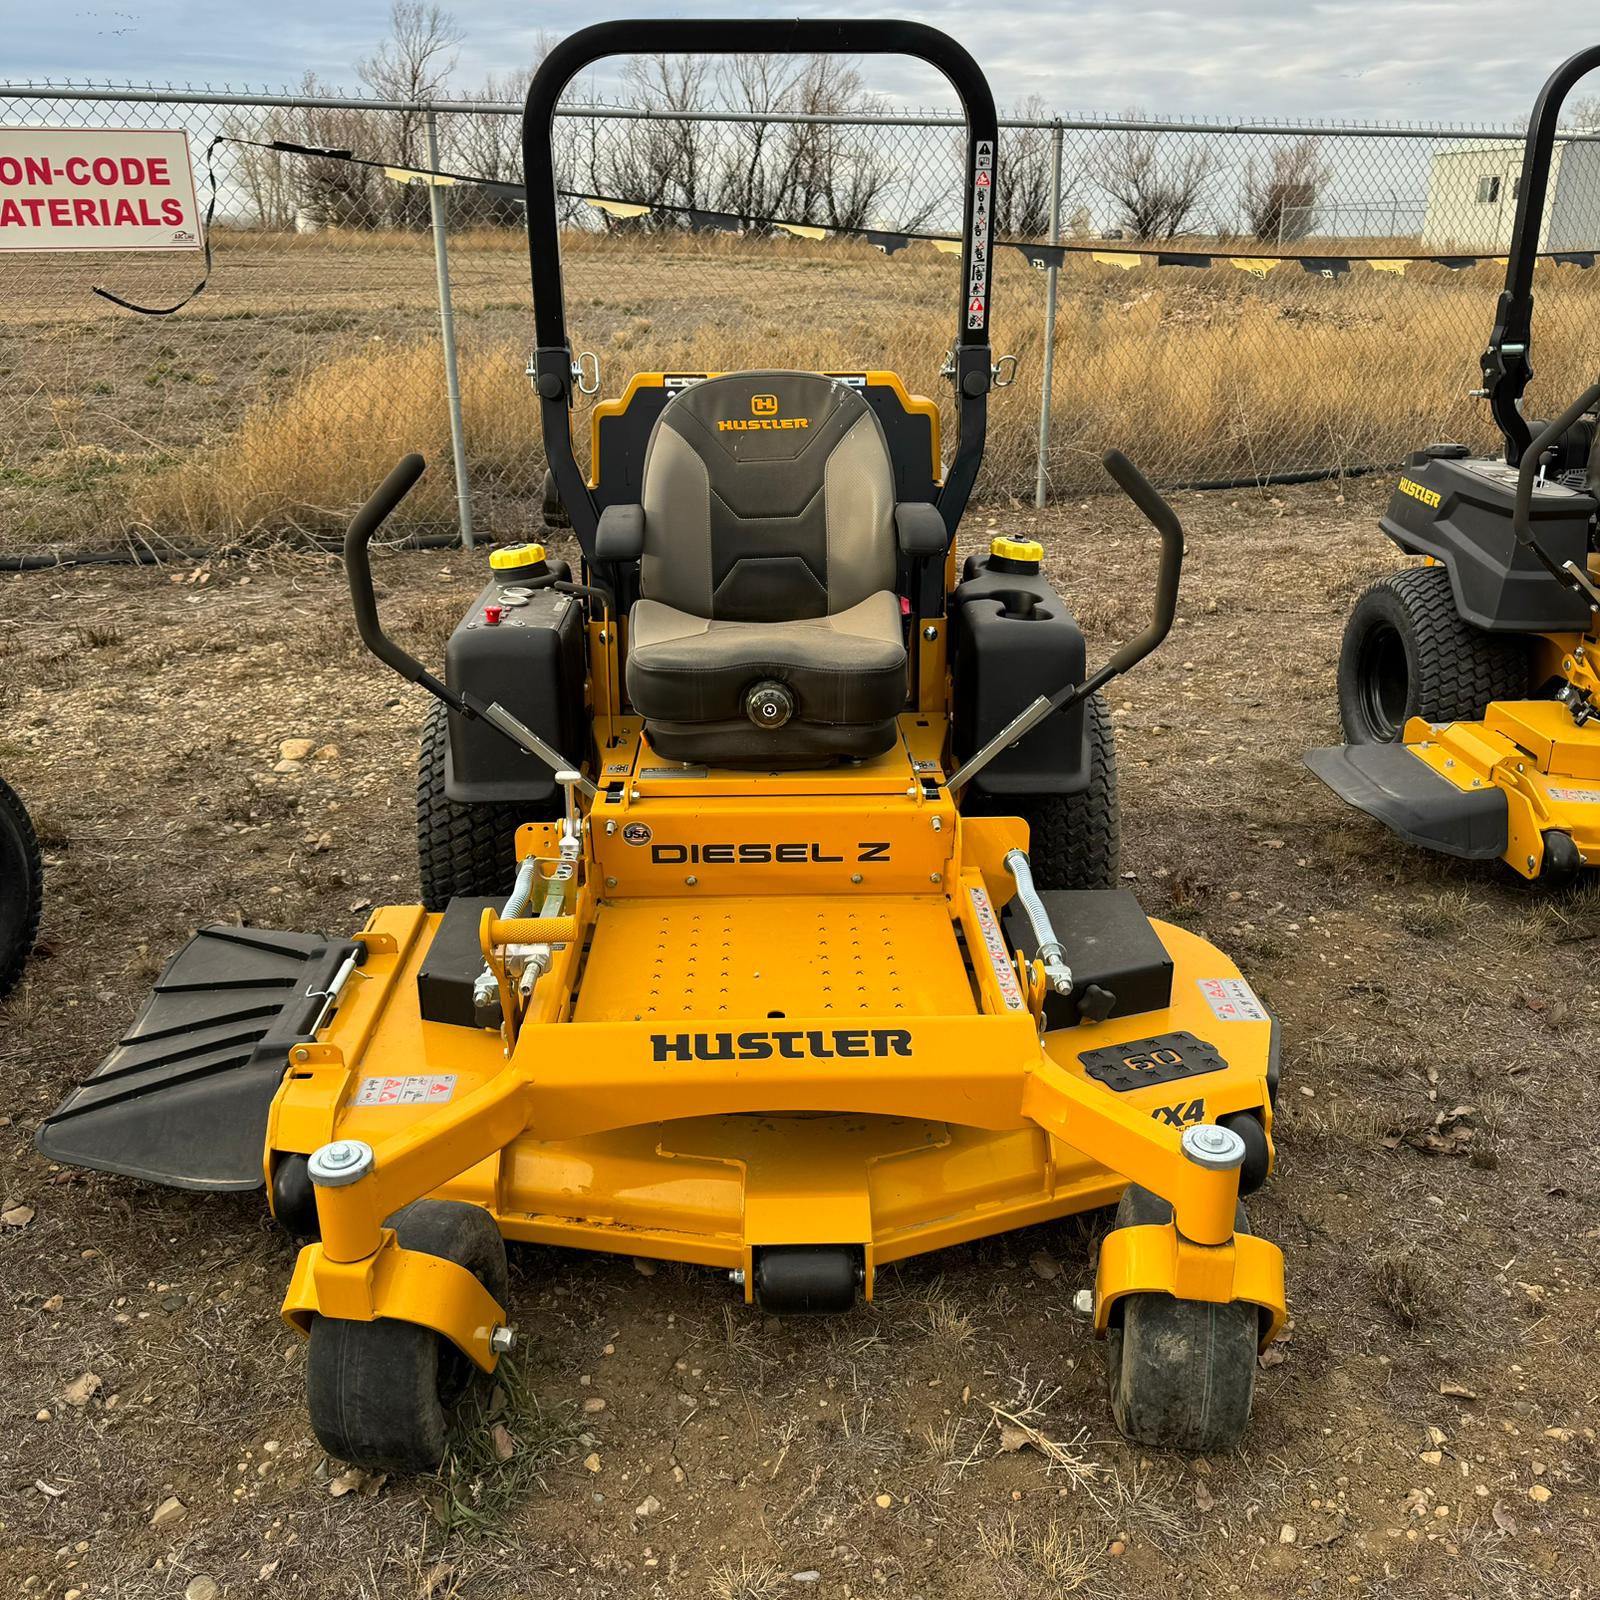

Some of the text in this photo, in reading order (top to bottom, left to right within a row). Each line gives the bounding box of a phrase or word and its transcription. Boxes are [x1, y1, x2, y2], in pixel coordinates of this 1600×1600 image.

[718, 418, 808, 431] HUSTLER
[1398, 476, 1442, 508] HUSTLER
[623, 830, 650, 839] USA
[651, 842, 890, 864] DIESEL Z
[650, 1029, 912, 1061] HUSTLER
[1122, 1047, 1183, 1070] 60
